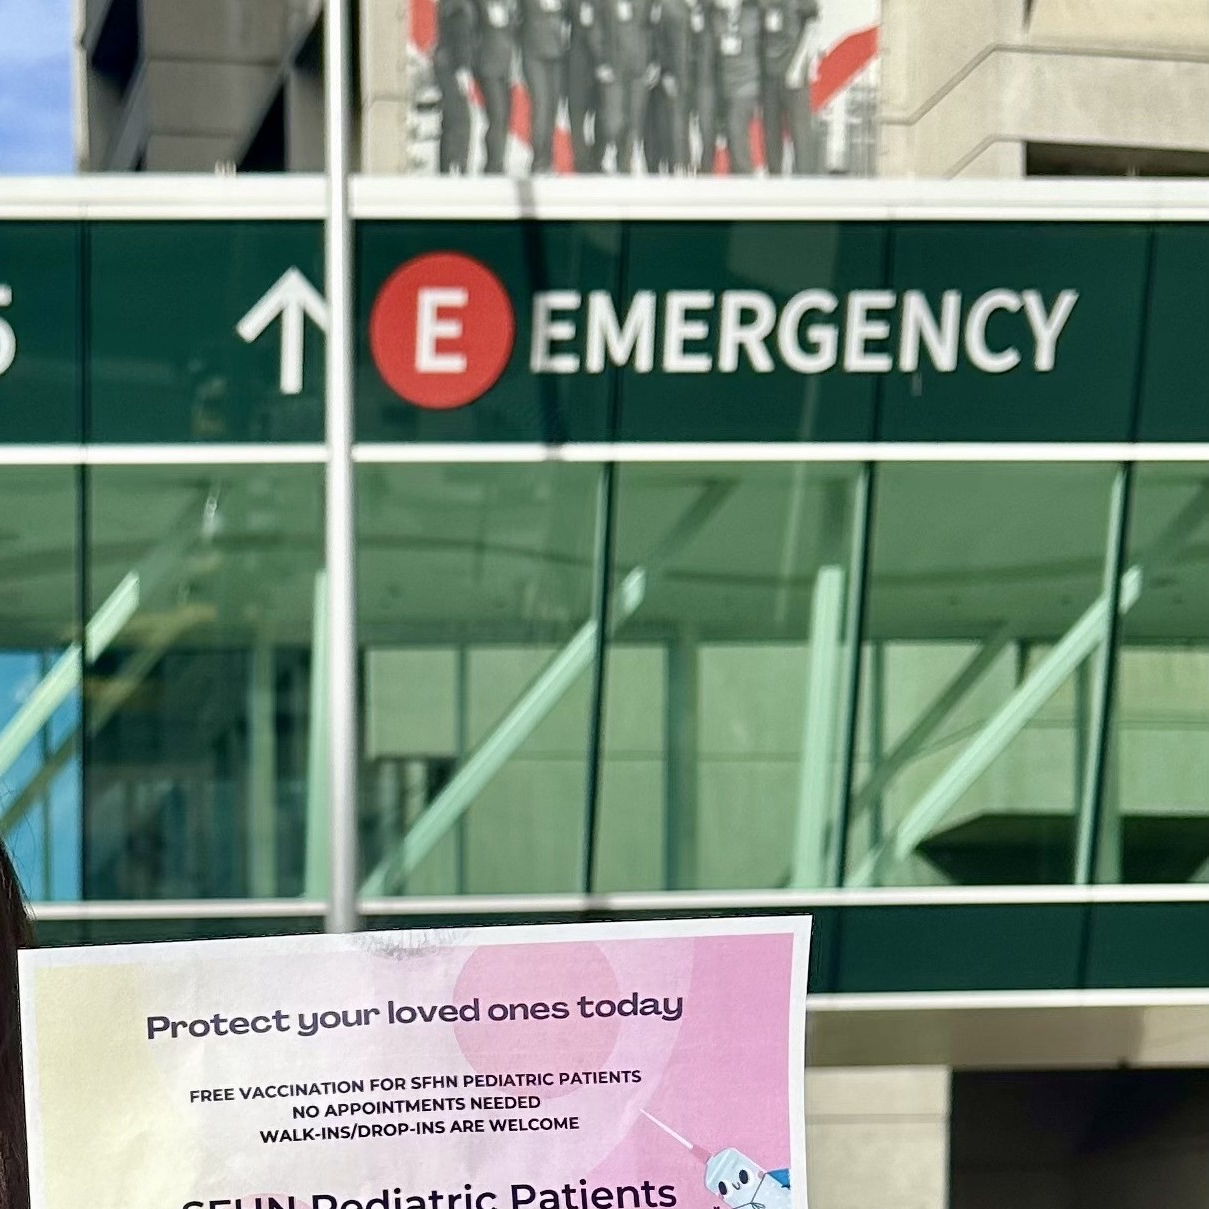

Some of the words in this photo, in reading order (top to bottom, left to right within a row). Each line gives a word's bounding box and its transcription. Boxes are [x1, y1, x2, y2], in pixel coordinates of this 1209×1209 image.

[414, 287, 469, 374] E
[529, 288, 1080, 375] EMERGENCY
[146, 1009, 291, 1040] Protect
[297, 1007, 381, 1037] your
[387, 997, 481, 1025] loved
[487, 1001, 570, 1022] ones
[576, 991, 684, 1022] today
[189, 1087, 235, 1104] FREE
[238, 1079, 365, 1100] VACCINATION
[369, 1077, 406, 1092] FOR
[410, 1075, 458, 1090] SFHN
[463, 1072, 555, 1088] PEDIATRIC
[558, 1069, 642, 1086] PATIENTS
[292, 1105, 320, 1120] NO
[324, 1097, 466, 1118] APPOINTMENTS
[470, 1095, 541, 1111] NEEDED
[259, 1120, 446, 1144] WALK-INS/DROP-INS
[449, 1119, 485, 1134] ARE
[488, 1116, 580, 1133] WELCOME
